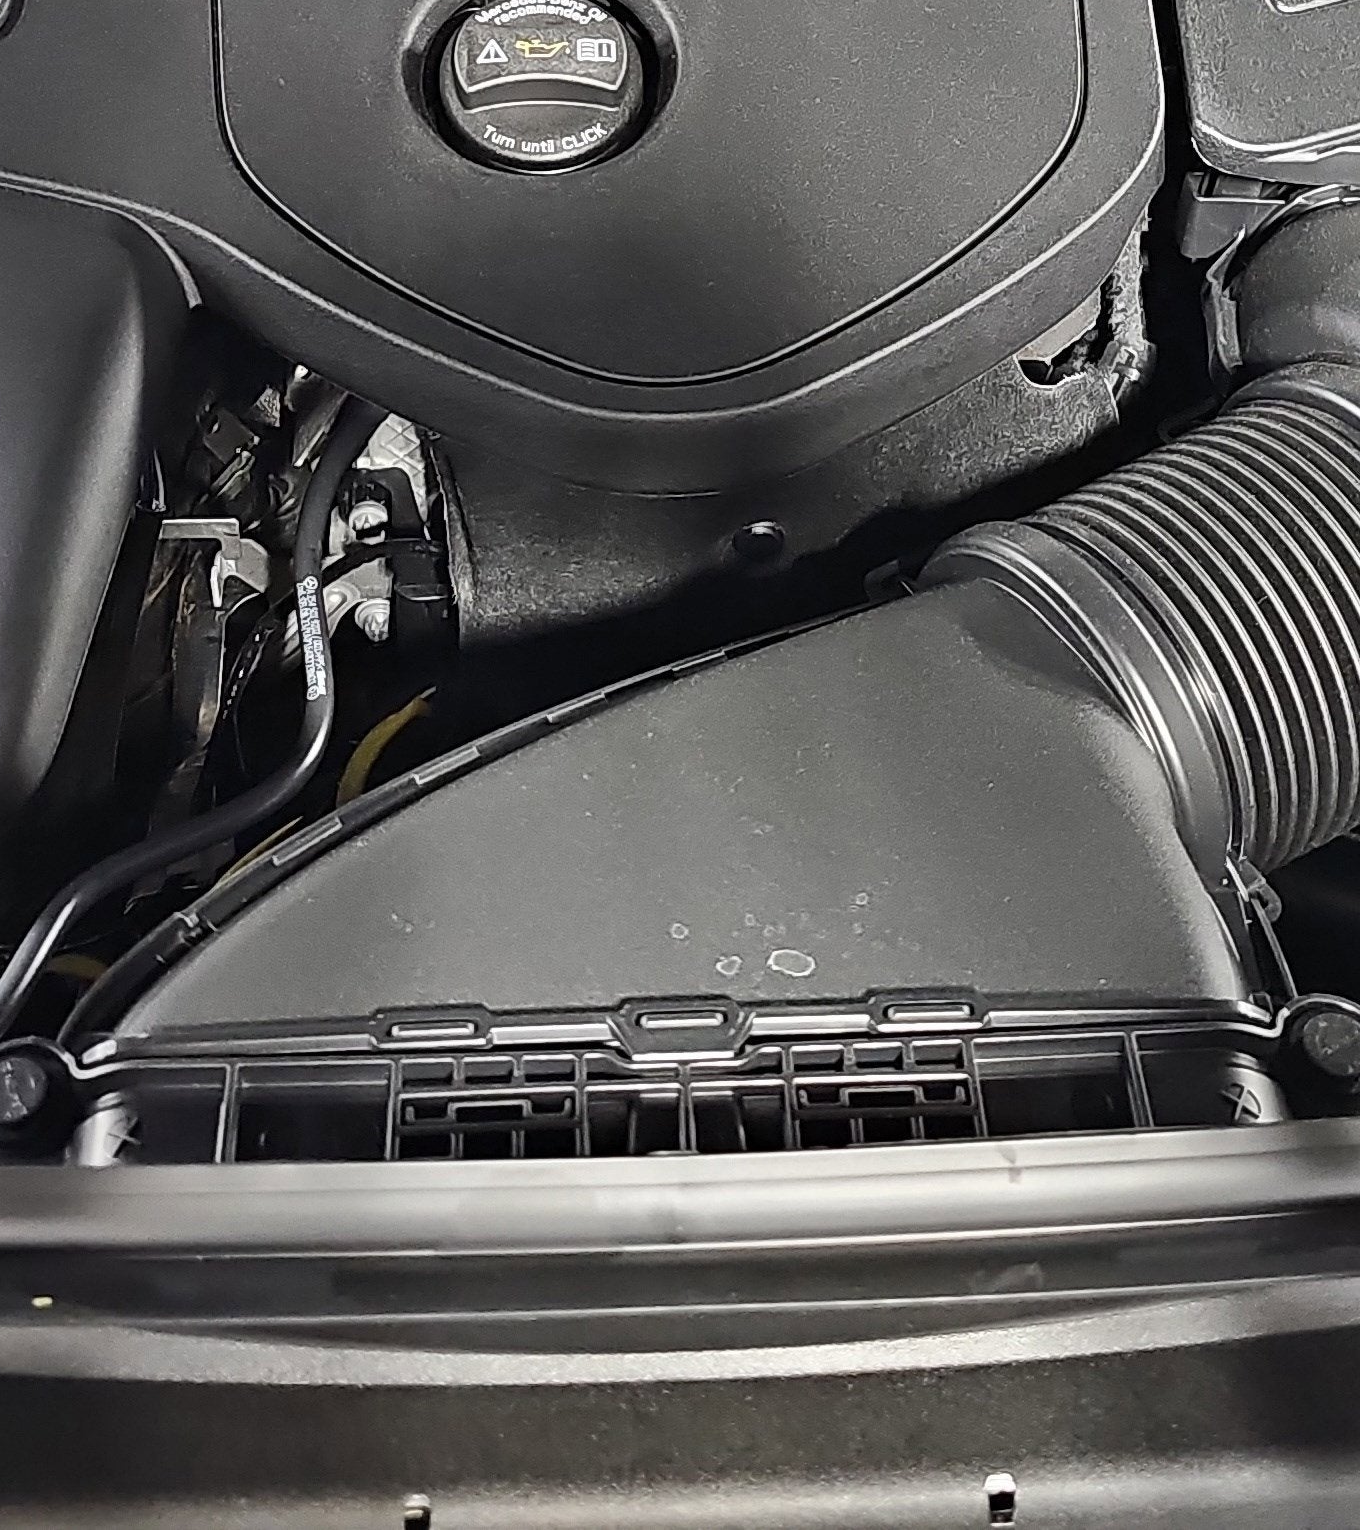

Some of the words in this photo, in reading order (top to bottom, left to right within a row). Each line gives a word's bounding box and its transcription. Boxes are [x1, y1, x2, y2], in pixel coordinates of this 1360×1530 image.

[493, 4, 591, 26] recommended
[483, 124, 516, 149] Turn
[521, 140, 555, 153] until
[561, 122, 608, 150] CLICK
